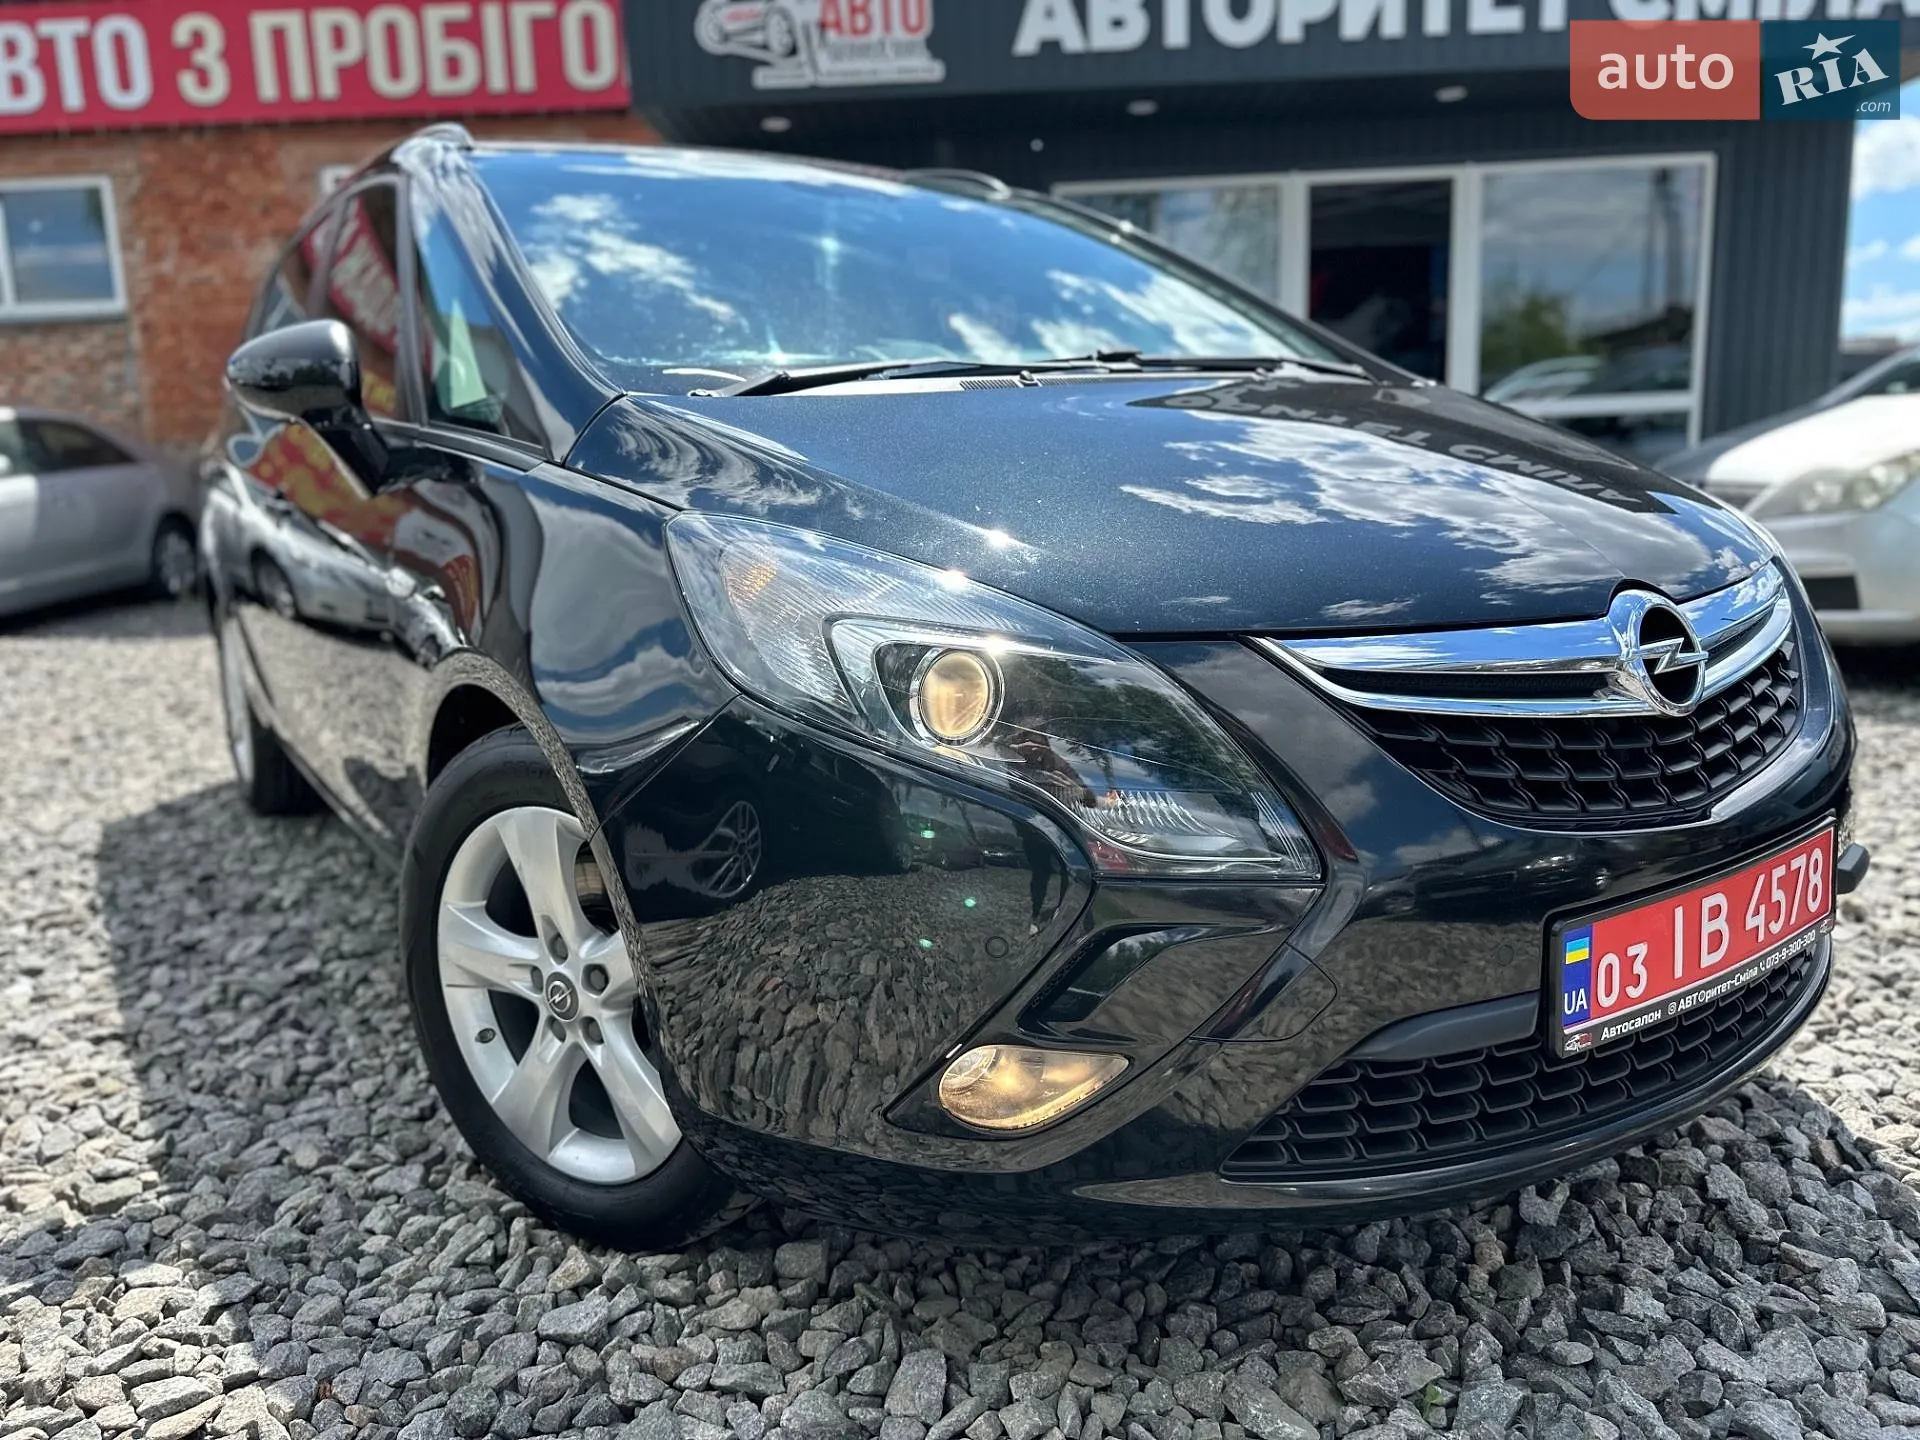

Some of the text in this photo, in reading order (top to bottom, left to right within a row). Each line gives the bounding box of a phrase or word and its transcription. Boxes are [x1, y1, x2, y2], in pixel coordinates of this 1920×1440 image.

[249, 0, 620, 102] ПРОБІГО
[1597, 942, 1649, 1009] 03
[1745, 848, 1823, 943] 4578
[1564, 988, 1588, 1015] UA
[1601, 1009, 1662, 1041] Автосалон
